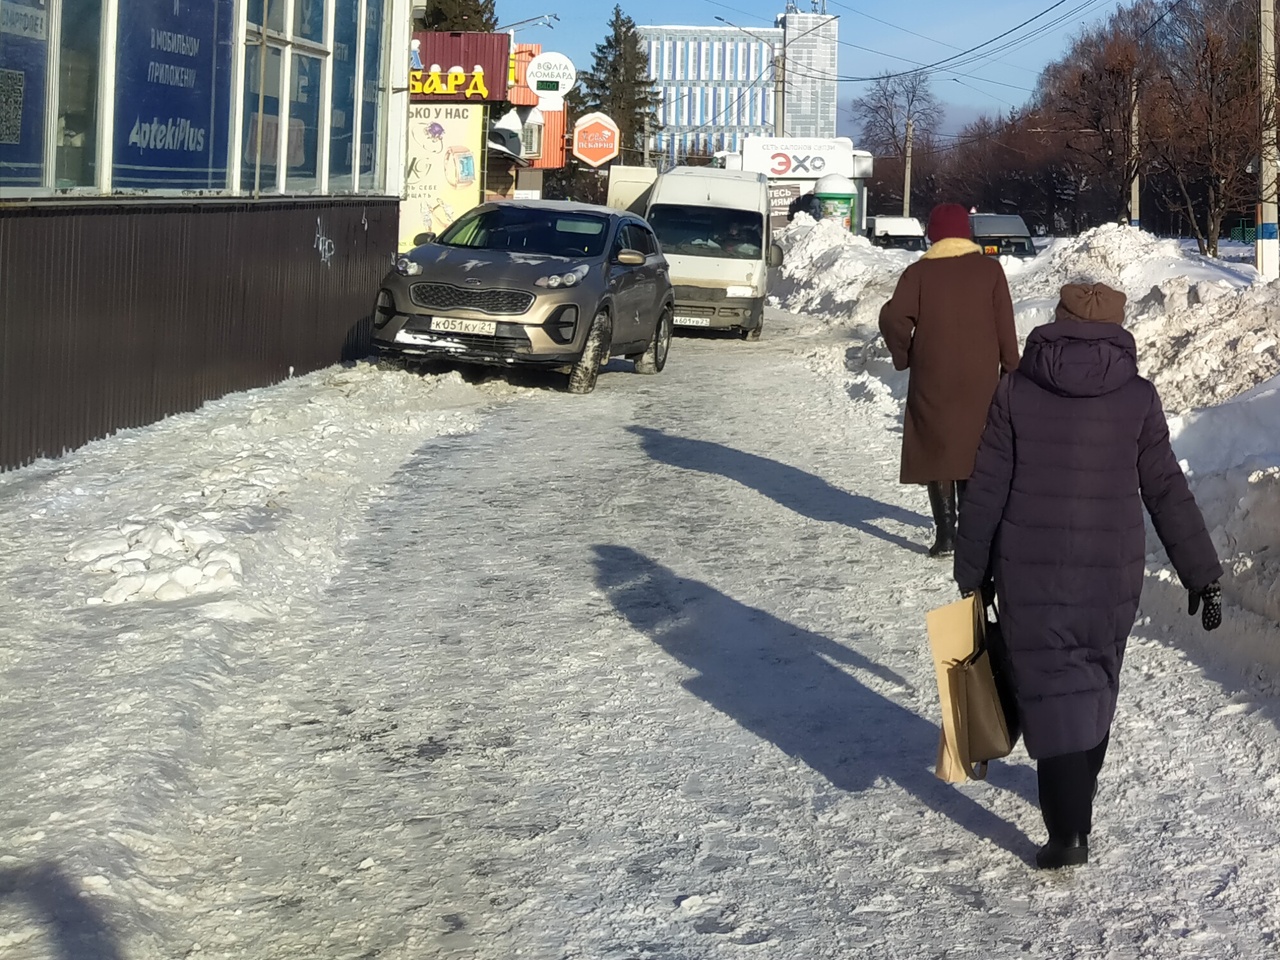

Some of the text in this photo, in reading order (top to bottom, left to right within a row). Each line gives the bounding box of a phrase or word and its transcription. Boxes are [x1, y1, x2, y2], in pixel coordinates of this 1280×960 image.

[156, 30, 200, 57] МОБИЛЬНОМ
[529, 71, 573, 80] ЛОМБАРД
[434, 108, 442, 119] У
[445, 108, 469, 119] НАС
[128, 114, 205, 155] AptekiPlus
[770, 152, 826, 176] ЭХО
